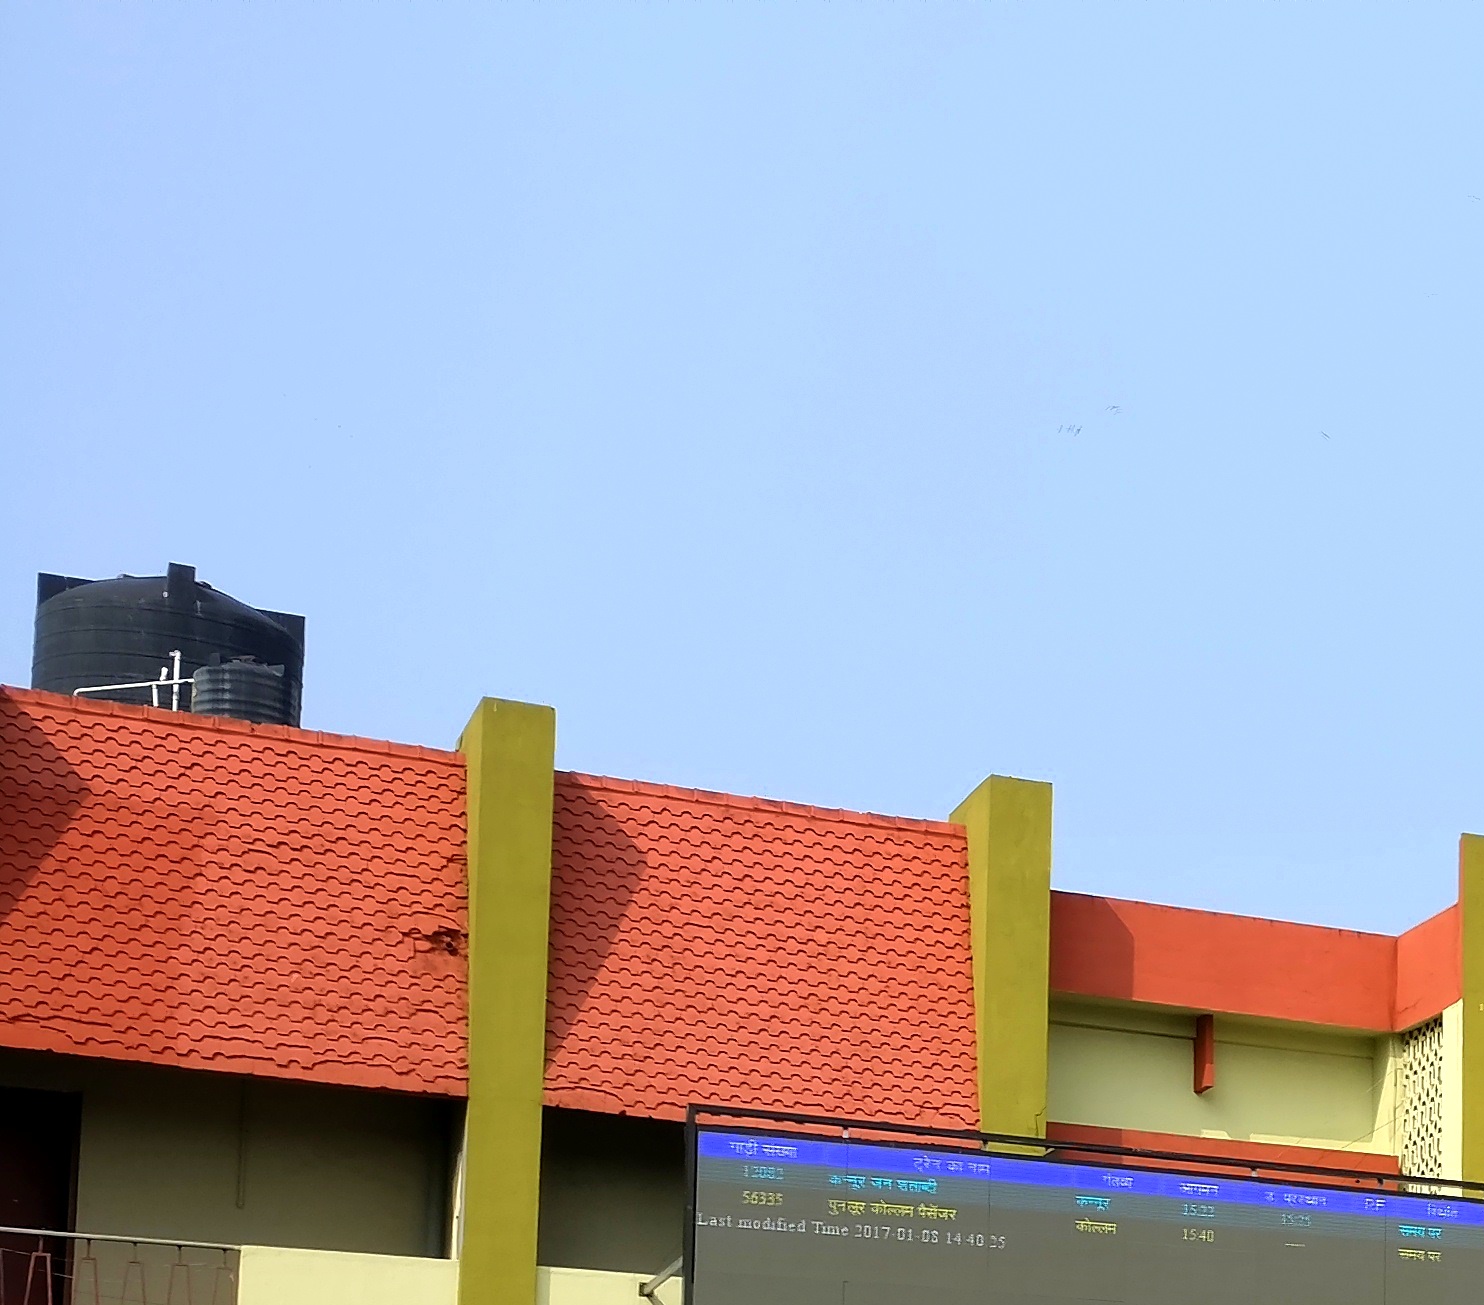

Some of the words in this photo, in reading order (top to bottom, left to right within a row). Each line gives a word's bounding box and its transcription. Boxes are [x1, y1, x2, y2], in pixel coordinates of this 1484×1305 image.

[697, 1212, 732, 1228] Last
[736, 1215, 806, 1233] modified
[811, 1220, 849, 1238] Time
